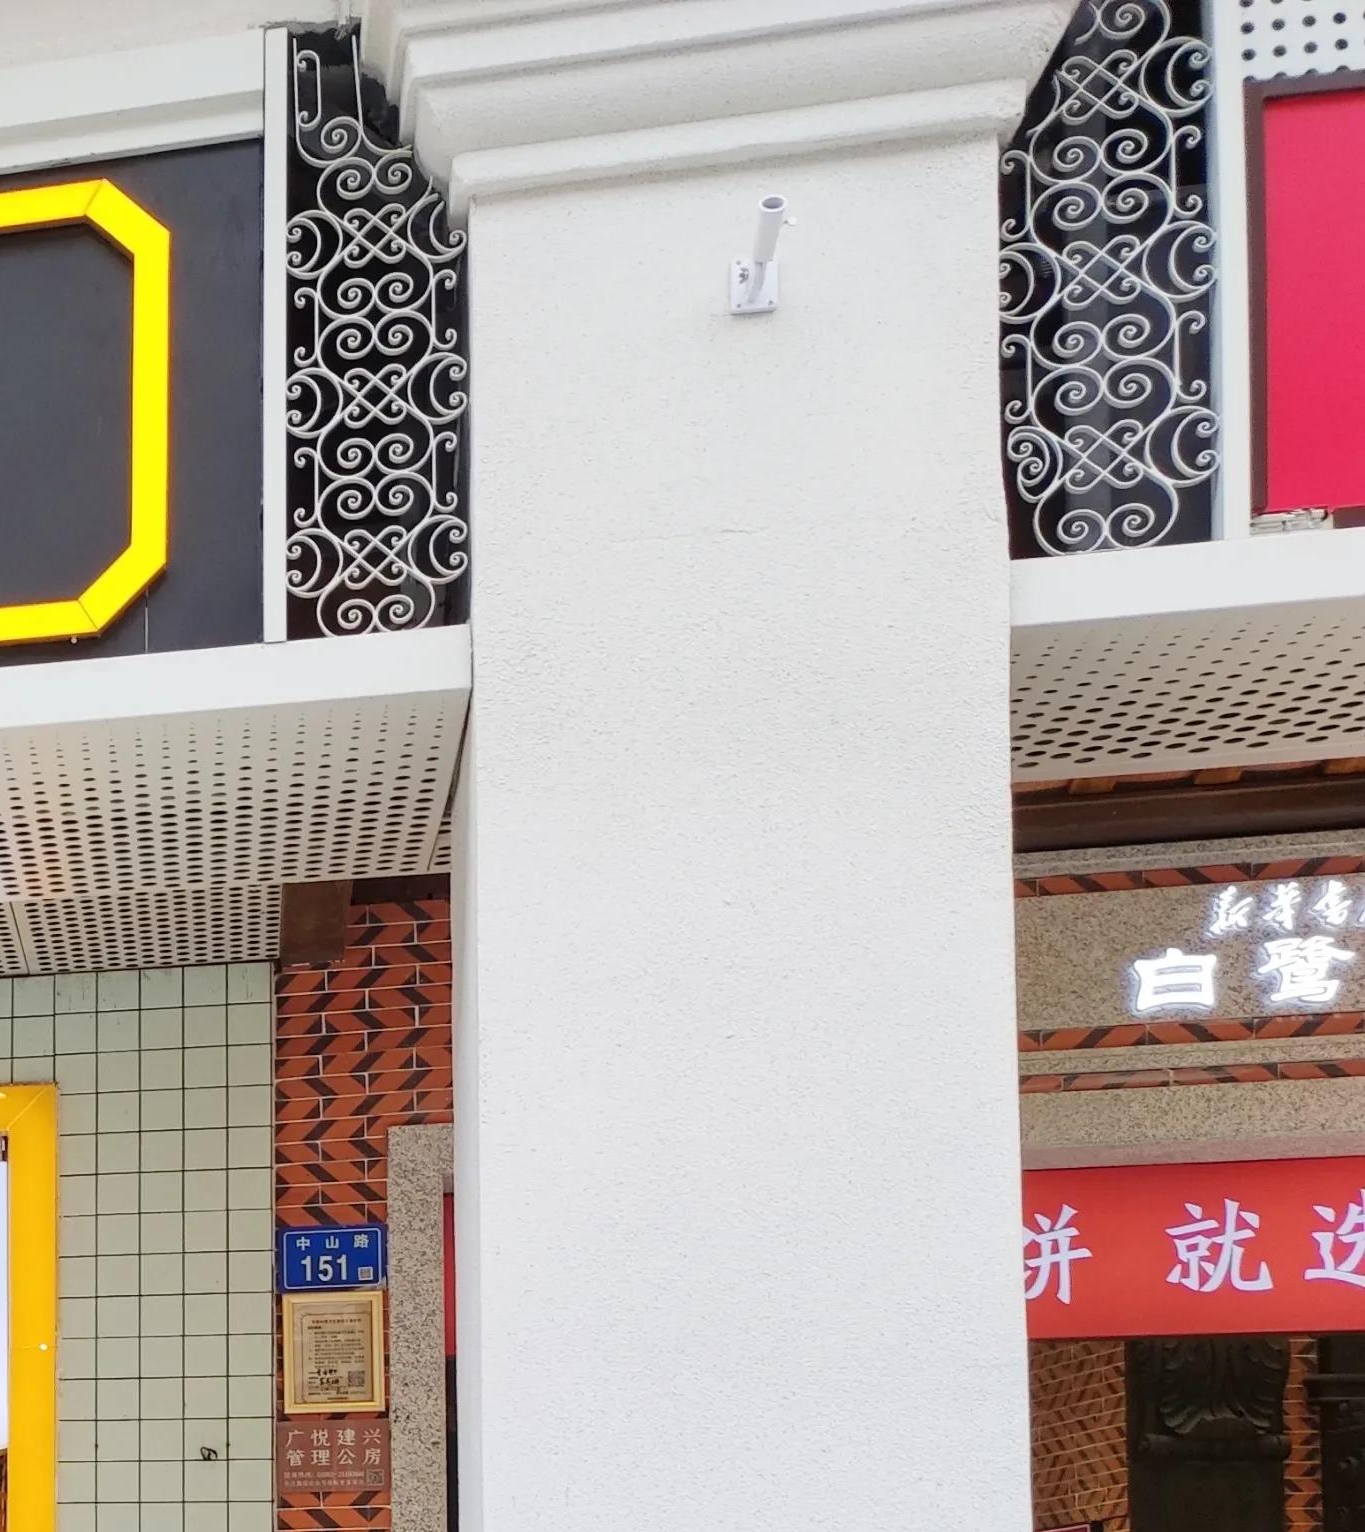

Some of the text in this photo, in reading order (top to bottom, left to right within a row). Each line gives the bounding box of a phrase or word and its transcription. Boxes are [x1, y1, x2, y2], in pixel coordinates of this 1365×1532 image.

[296, 1234, 369, 1251] 中山路
[301, 1254, 347, 1281] 151
[285, 1428, 382, 1447] 广悦建兴
[286, 1448, 382, 1467] 管理公房
